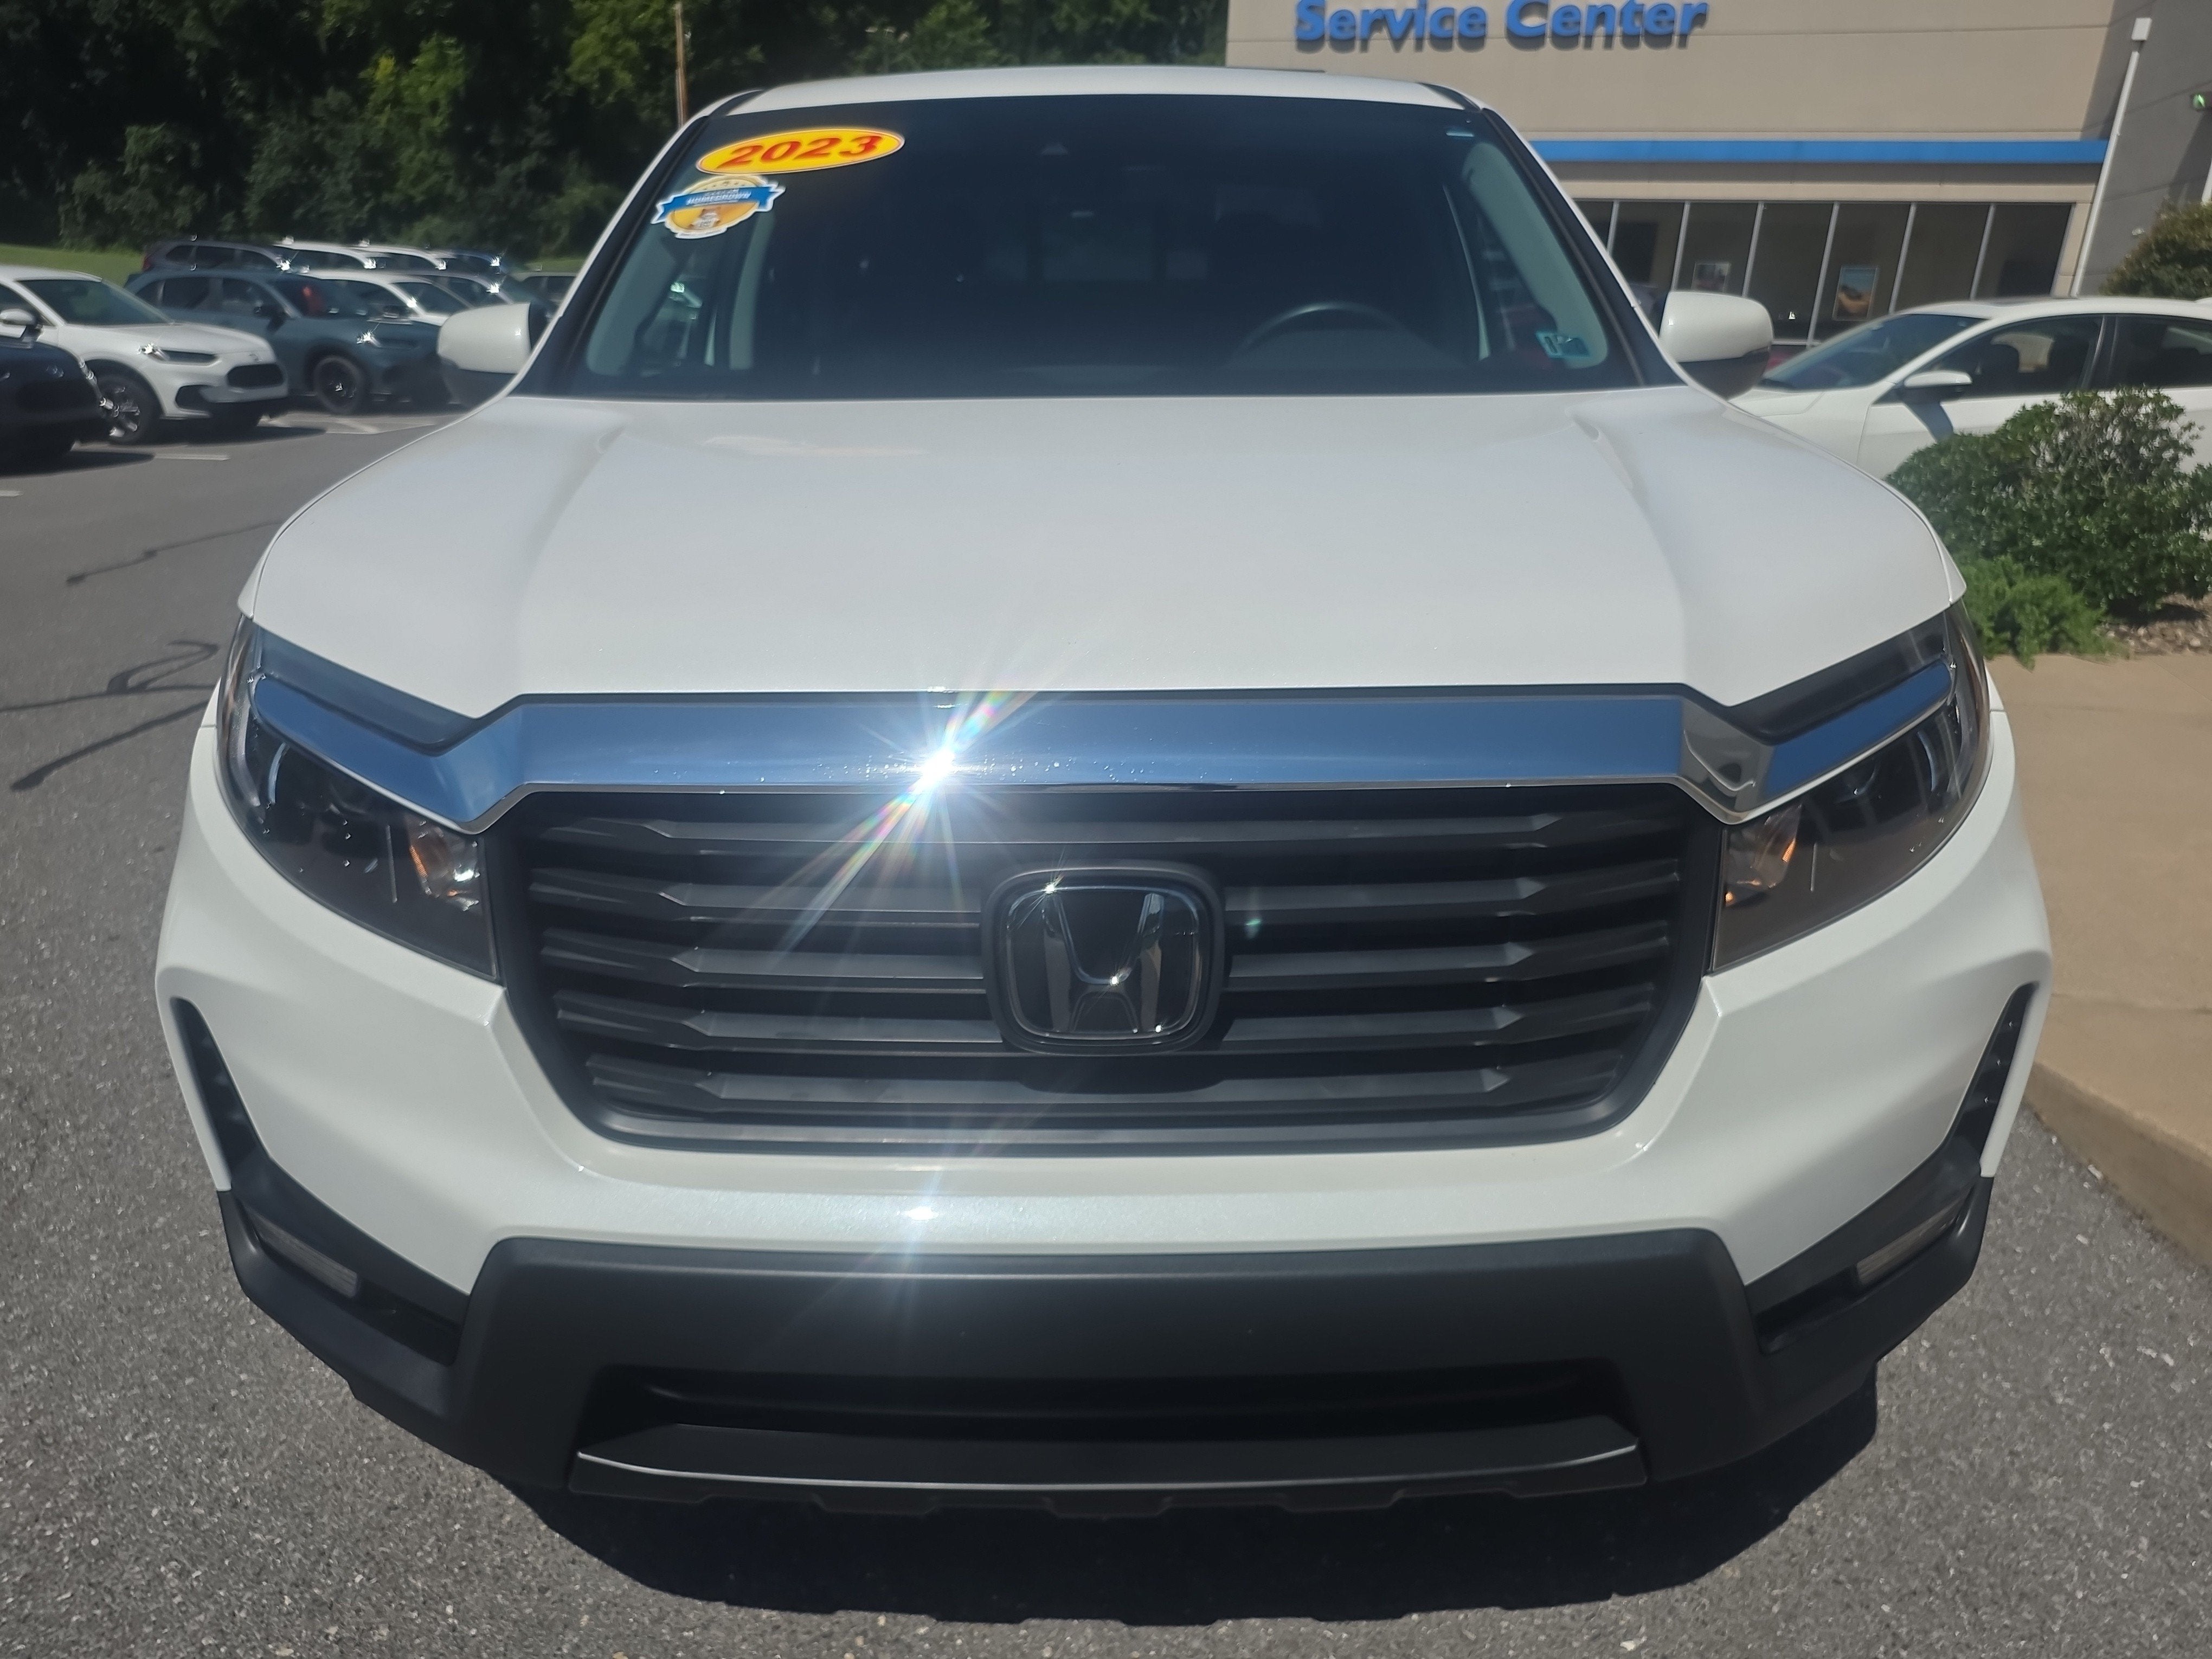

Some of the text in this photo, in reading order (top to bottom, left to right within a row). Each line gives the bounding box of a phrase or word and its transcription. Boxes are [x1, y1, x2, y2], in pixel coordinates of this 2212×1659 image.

[1295, 0, 1708, 40] Service Center
[716, 136, 883, 170] 2023
